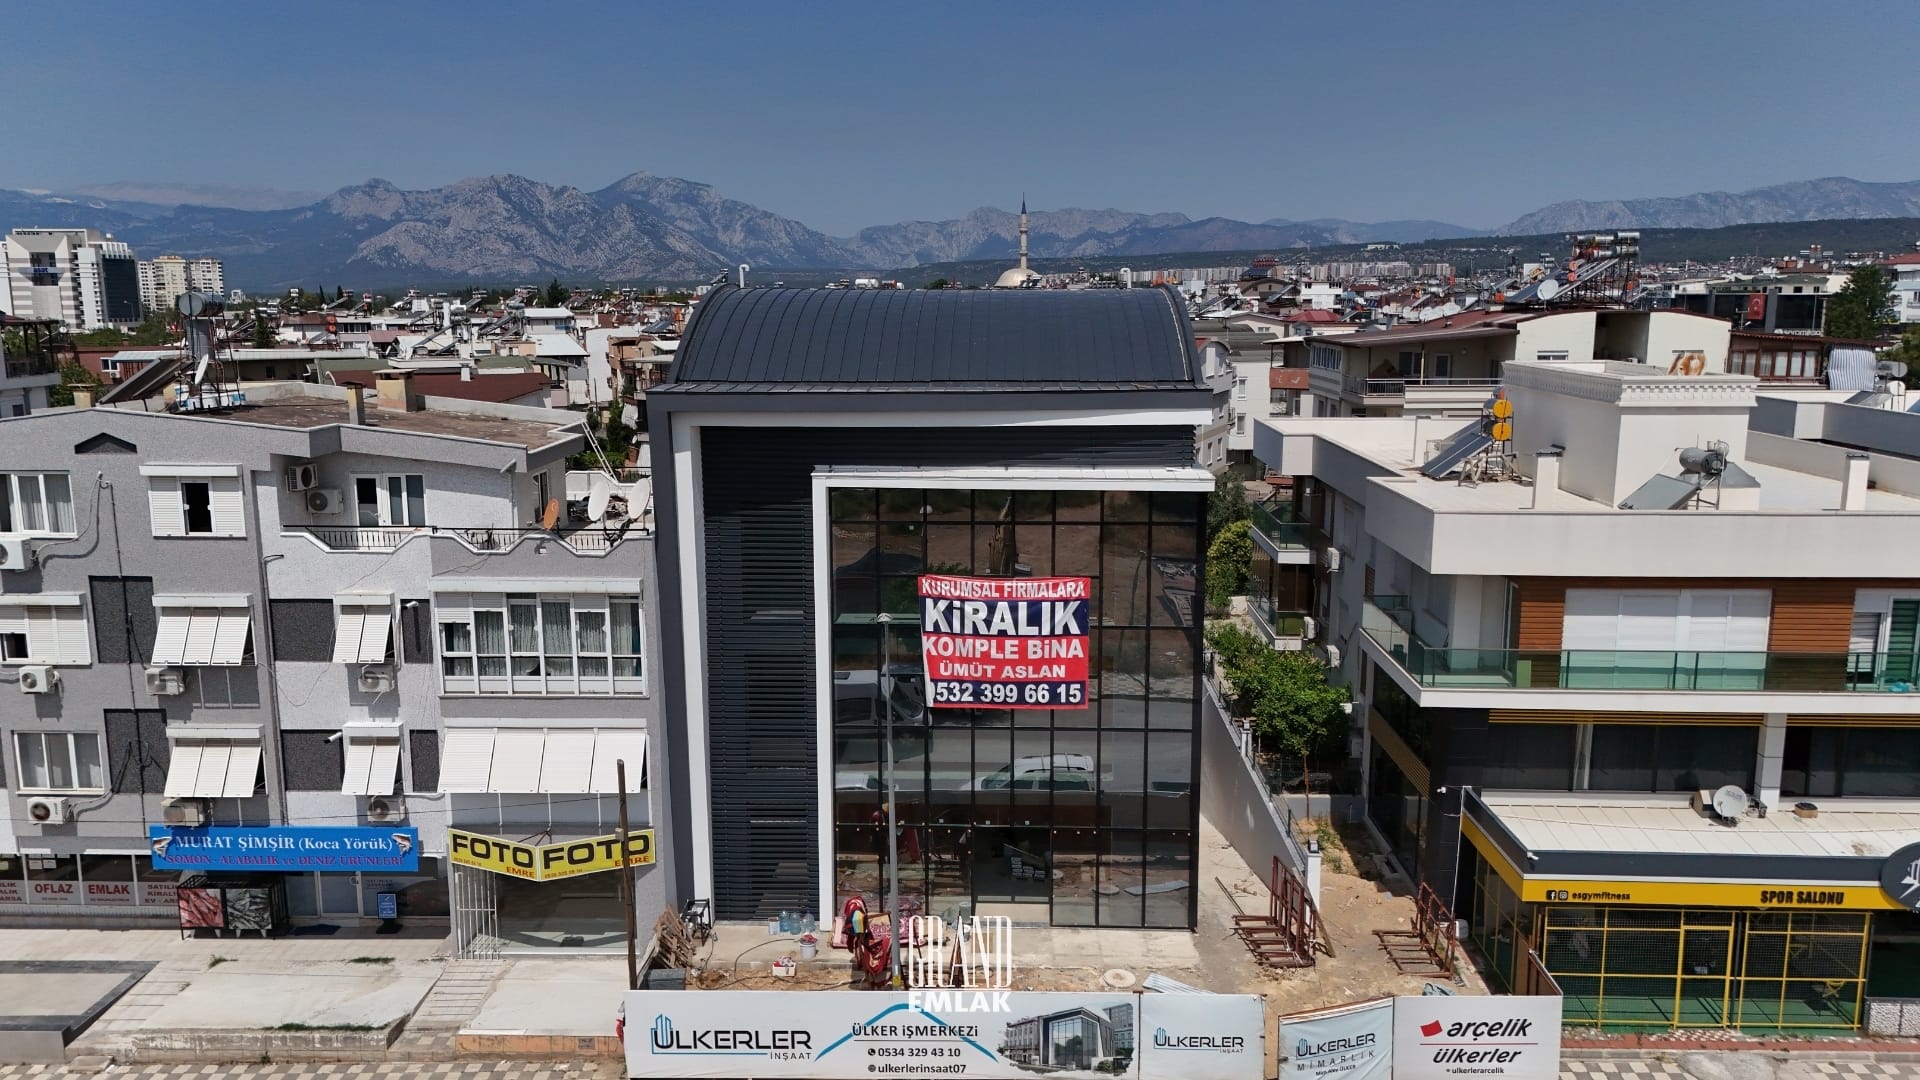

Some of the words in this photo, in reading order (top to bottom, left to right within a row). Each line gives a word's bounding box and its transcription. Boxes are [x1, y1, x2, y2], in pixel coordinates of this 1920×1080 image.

[922, 579, 1000, 598] KURUMSAL
[1003, 580, 1085, 598] FİRMALARA
[923, 636, 1019, 660] KOMPLE
[939, 662, 996, 678] ÜMÜT
[1000, 665, 1066, 679] ASLAN
[980, 683, 1018, 703] 399
[1024, 683, 1050, 703] 66
[1056, 683, 1081, 703] 15
[175, 836, 234, 849] MURAT
[238, 834, 295, 852] ŞİMŞİR
[298, 838, 340, 852] (Koca
[343, 837, 393, 852] Yörük)
[452, 834, 534, 868] FOTO
[543, 834, 650, 869] FOTO
[166, 855, 211, 865] SOMON
[219, 855, 279, 866] ALABALIK
[506, 866, 535, 878] EMRE
[34, 883, 74, 894] OFLAZ
[88, 884, 130, 895] EMLAK
[1760, 891, 1794, 904] SPOR
[1797, 891, 1845, 905] SALONU
[852, 1022, 898, 1037] ÜLKER
[1446, 1018, 1532, 1041] arçelik
[770, 1052, 813, 1061] İNŞAAT
[877, 1048, 905, 1057] 0534
[907, 1048, 928, 1057] 329
[930, 1048, 945, 1057] 43
[947, 1048, 961, 1057] 10
[1433, 1048, 1522, 1064] ülkerler
[877, 1064, 967, 1074] ulkerlerinsaat07
